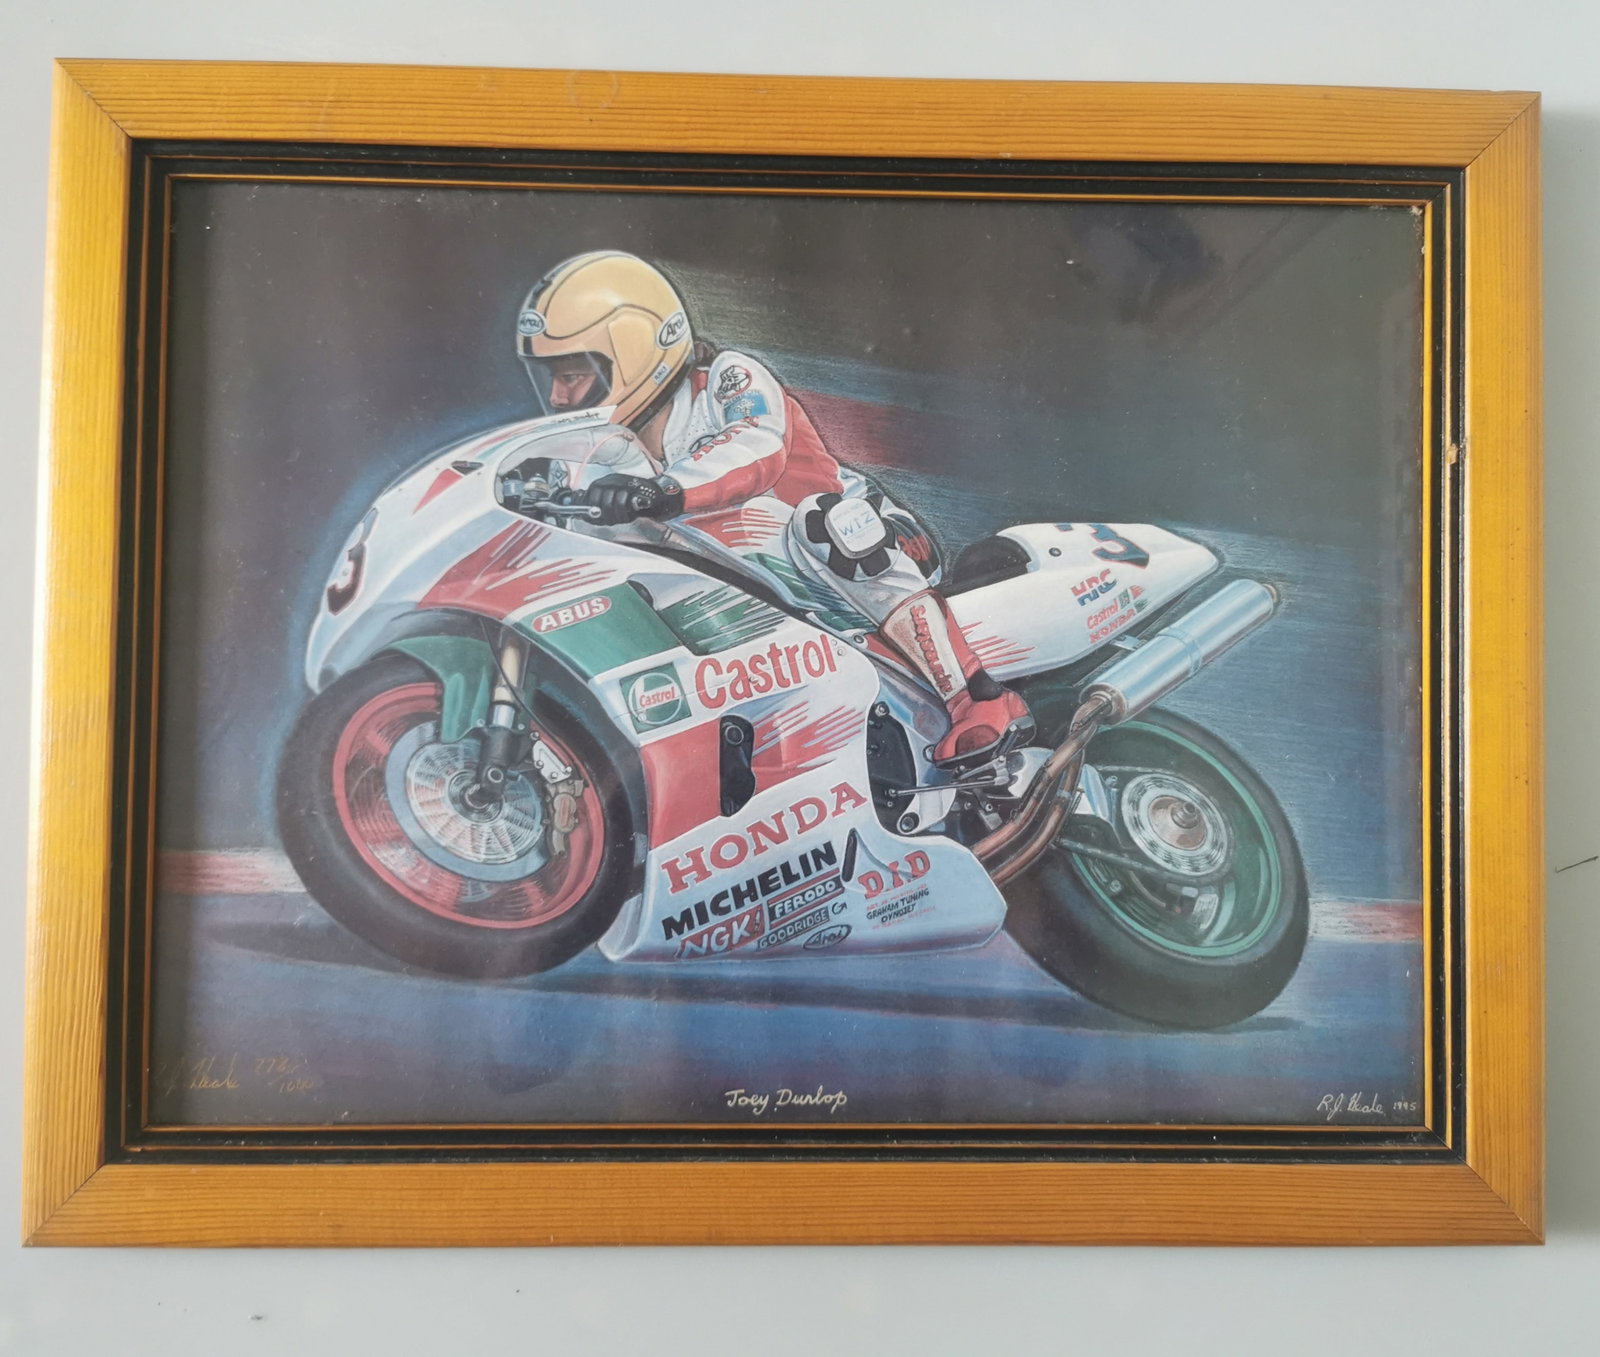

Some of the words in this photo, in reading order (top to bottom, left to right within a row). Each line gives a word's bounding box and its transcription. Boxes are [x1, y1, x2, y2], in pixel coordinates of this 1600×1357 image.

[838, 509, 876, 538] WIZ
[1070, 568, 1119, 606] HRC
[540, 598, 605, 632] ABUS
[1087, 597, 1119, 630] Castrol
[694, 633, 838, 710] Castrol
[639, 686, 676, 708] Castrol
[661, 781, 868, 894] HONDA
[661, 840, 838, 940] MICHELIN
[774, 880, 836, 918] FERODO
[866, 901, 899, 920] GRAHAM
[900, 887, 929, 906] TUNING
[759, 909, 829, 950] GOODRIDGE
[724, 1088, 770, 1116] Joey
[775, 1084, 848, 1115] Dunlop
[1392, 1101, 1417, 1111] 1995
